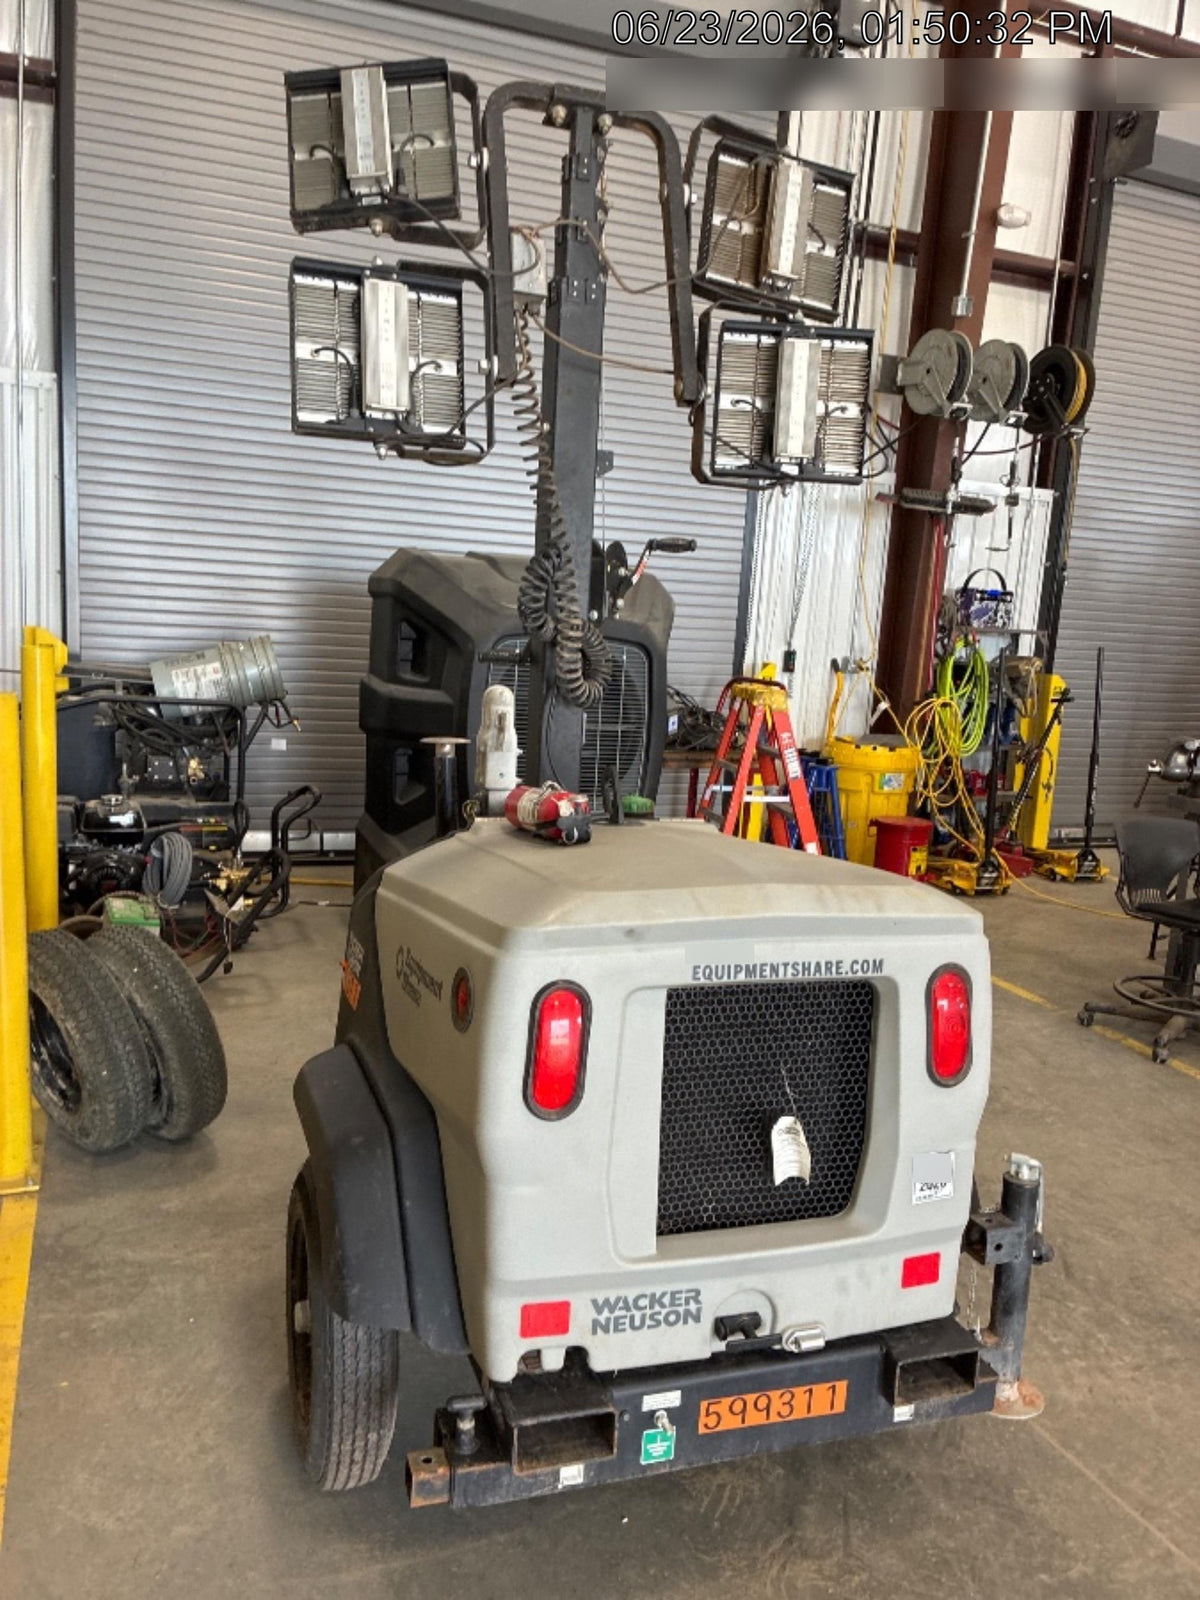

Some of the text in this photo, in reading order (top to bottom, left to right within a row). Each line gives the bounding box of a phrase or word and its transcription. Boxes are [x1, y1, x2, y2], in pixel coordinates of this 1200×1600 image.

[692, 958, 884, 981] EQUIPMENTSHARE.COM
[590, 1288, 702, 1316] WACKER
[591, 1306, 702, 1336] NEUSON
[703, 1384, 838, 1431] 599311
